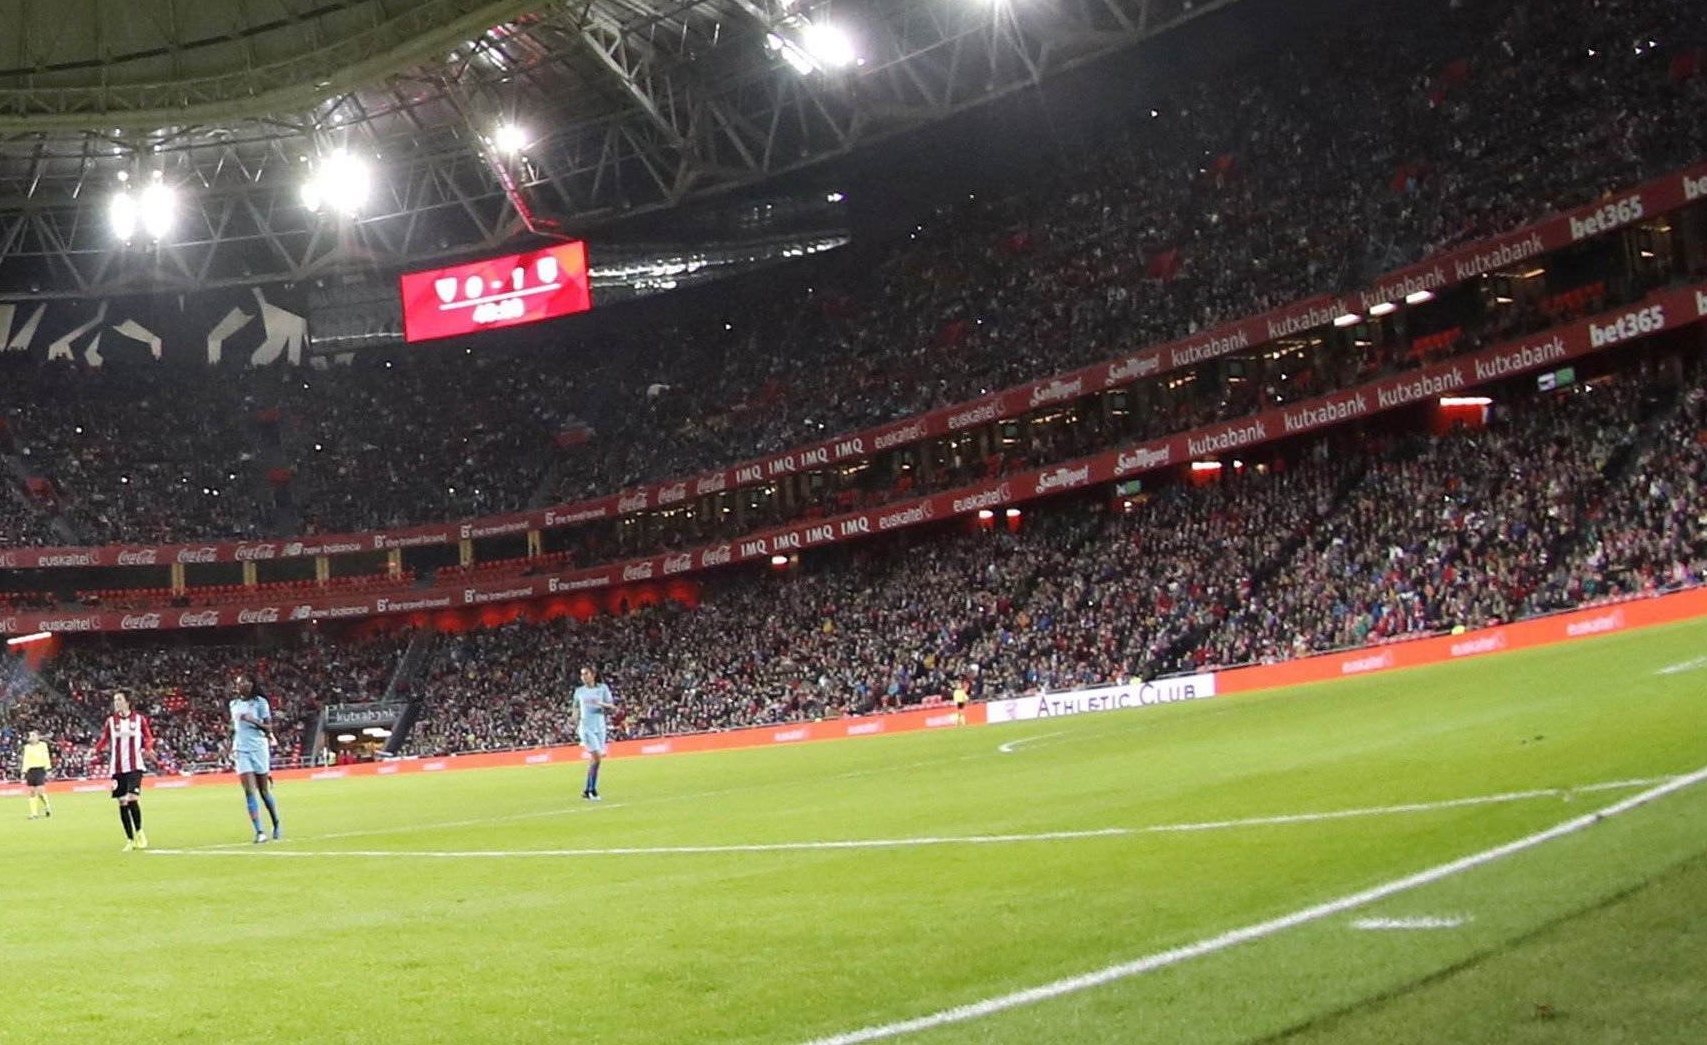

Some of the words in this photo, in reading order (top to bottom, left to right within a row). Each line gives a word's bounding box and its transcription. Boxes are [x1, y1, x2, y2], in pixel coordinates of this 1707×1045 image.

[1570, 195, 1643, 240] bet365
[1455, 232, 1545, 279] kutxabank
[1361, 268, 1446, 308] kutxabank
[1268, 300, 1348, 338] kutxabank
[1589, 305, 1665, 348] bet365
[1172, 331, 1248, 367] kutxabank
[1475, 336, 1565, 380] kutxabank
[1378, 367, 1464, 407] kutxabank
[1285, 393, 1366, 431] kutxabank
[835, 438, 864, 458] IMQ
[874, 425, 918, 450] euskaltel
[1188, 422, 1266, 456] kutxabank
[769, 457, 795, 475] IMQ
[801, 447, 829, 466] IMQ
[736, 465, 762, 483] IMQ
[953, 487, 1001, 513] euskaltel
[841, 517, 869, 536] IMQ
[879, 505, 924, 529] euskaltel
[773, 532, 800, 550] IMQ
[806, 524, 834, 544] IMQ
[303, 545, 321, 555] new
[323, 541, 361, 554] balance
[741, 539, 767, 557] IMQ
[38, 554, 90, 568] euskaltel
[311, 609, 329, 618] new
[331, 605, 369, 617] balance
[40, 618, 91, 632] euskaltel
[1037, 693, 1131, 717] ATHLETIC
[1140, 683, 1196, 706] CLUB
